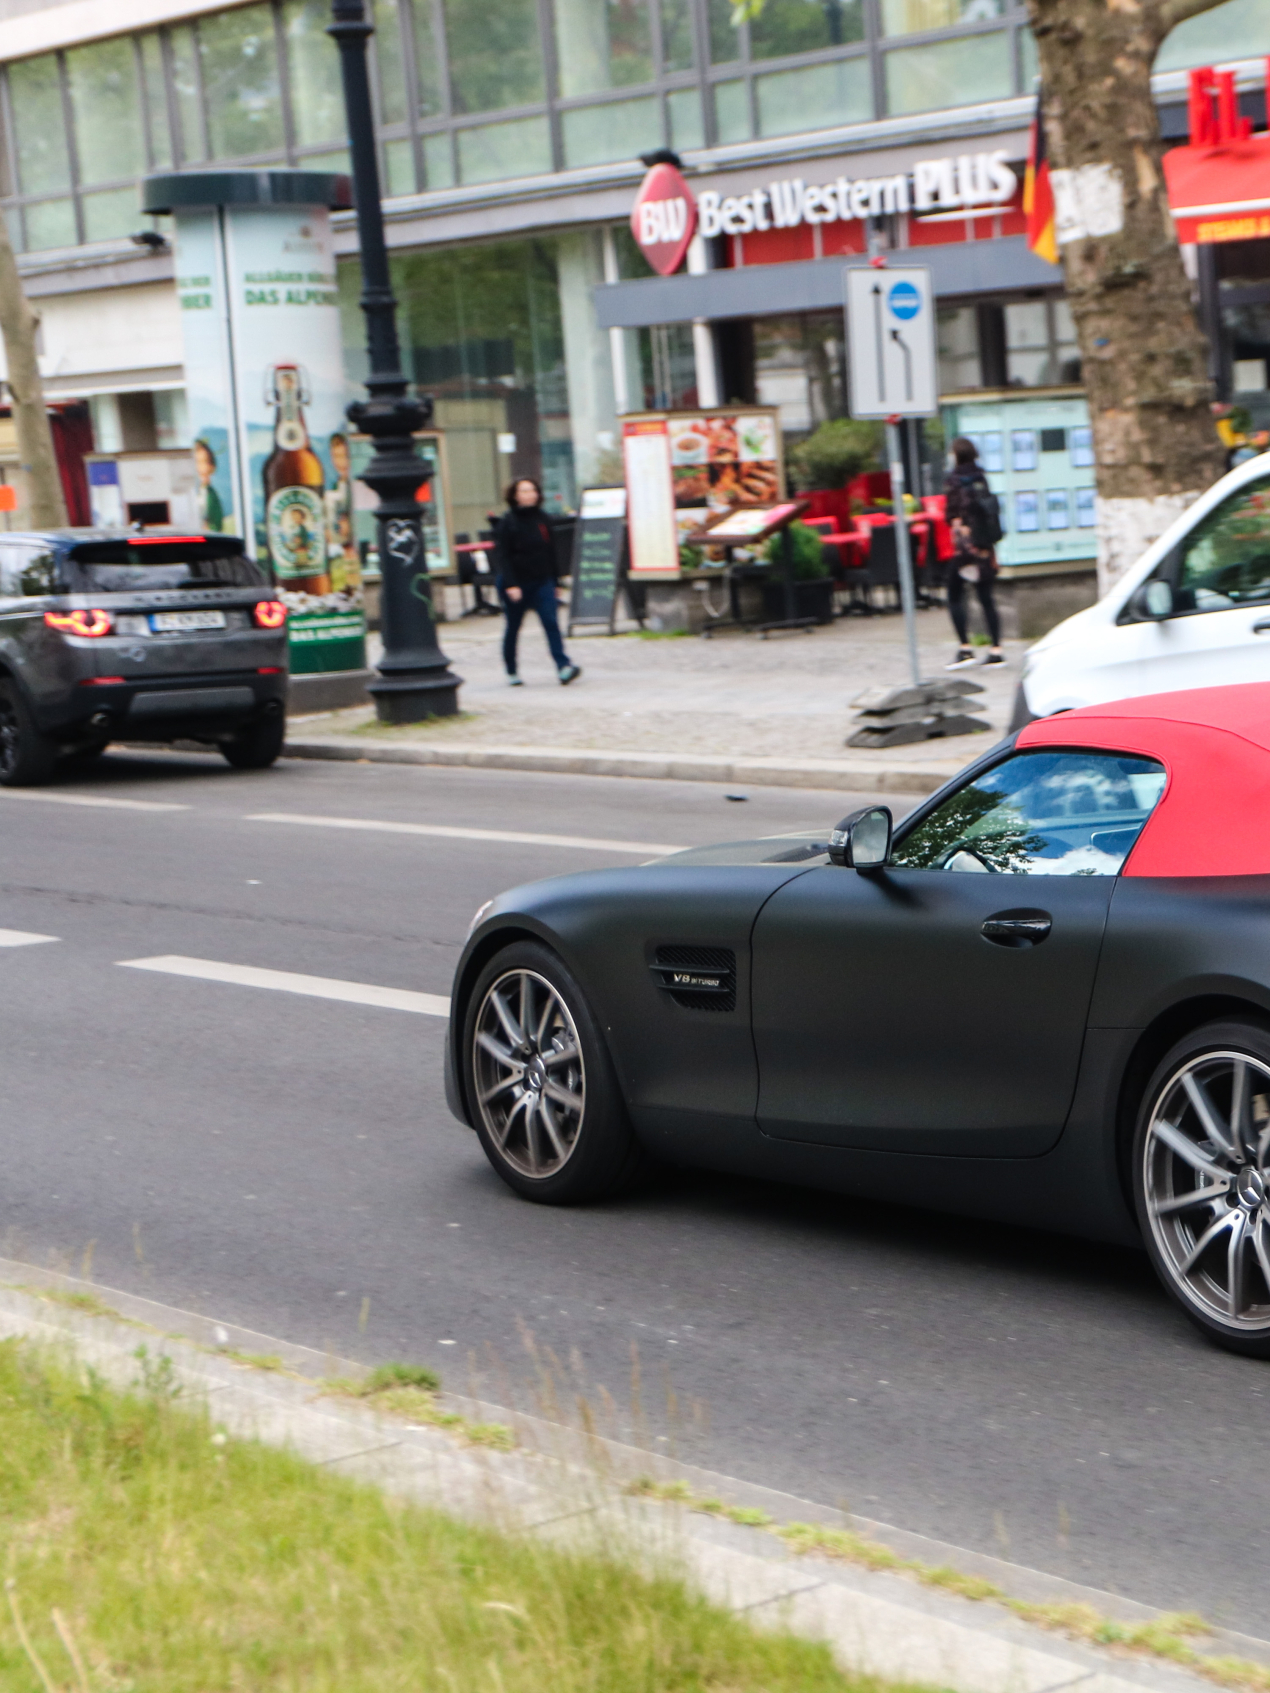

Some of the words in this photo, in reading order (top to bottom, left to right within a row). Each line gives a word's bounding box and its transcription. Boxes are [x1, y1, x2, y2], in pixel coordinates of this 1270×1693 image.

[699, 189, 771, 239] Best
[769, 174, 910, 228] Western
[913, 149, 1018, 211] PLUS
[640, 196, 688, 246] BW
[244, 290, 280, 305] DAS
[673, 973, 691, 983] V8
